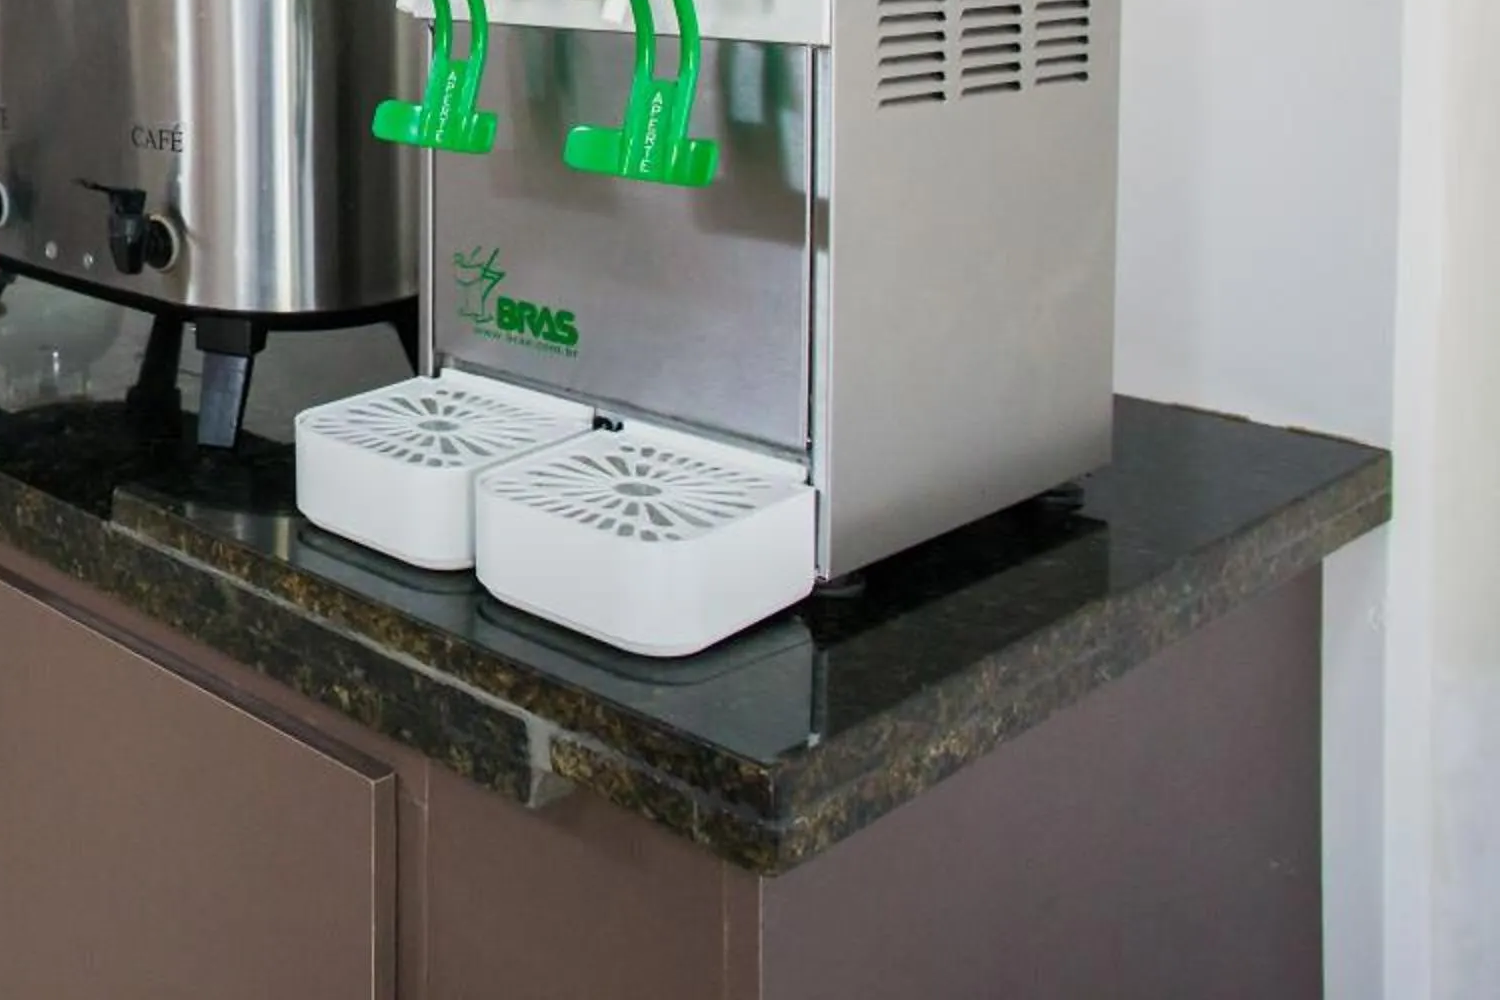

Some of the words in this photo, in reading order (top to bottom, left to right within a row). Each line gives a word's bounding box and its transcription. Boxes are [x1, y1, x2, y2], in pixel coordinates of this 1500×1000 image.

[131, 122, 184, 153] CAFÉ
[435, 70, 457, 143] APERTE
[639, 91, 664, 174] APERTE
[497, 295, 579, 346] BRAS
